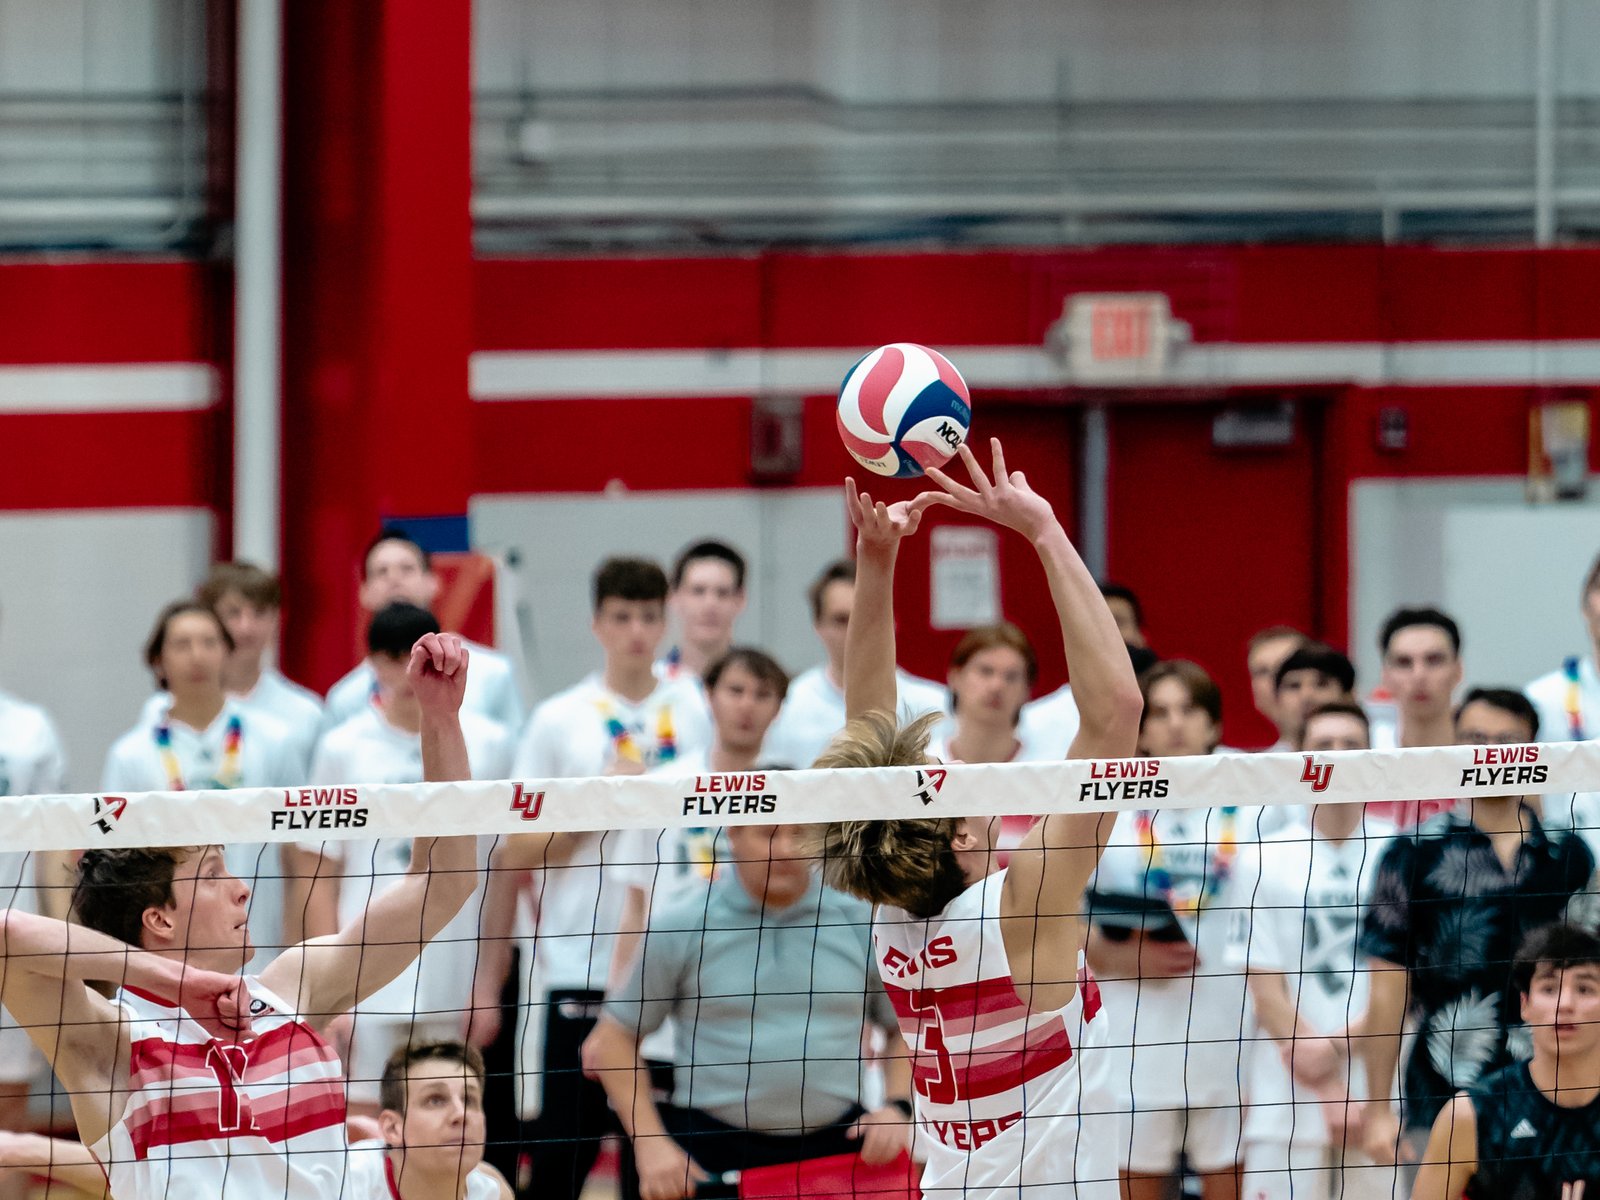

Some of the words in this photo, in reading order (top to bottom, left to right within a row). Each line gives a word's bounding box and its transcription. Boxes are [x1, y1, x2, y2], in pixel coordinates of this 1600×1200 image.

[1473, 746, 1539, 765] LEWIS
[1090, 760, 1160, 779] LEWIS
[1300, 755, 1334, 792] LU
[1460, 765, 1548, 787] FLYERS
[694, 774, 766, 793] LEWIS
[1079, 779, 1169, 801] FLYERS
[284, 788, 358, 807] LEWIS
[509, 782, 545, 821] LU
[682, 794, 777, 815] FLYERS
[271, 808, 368, 830] FLYERS
